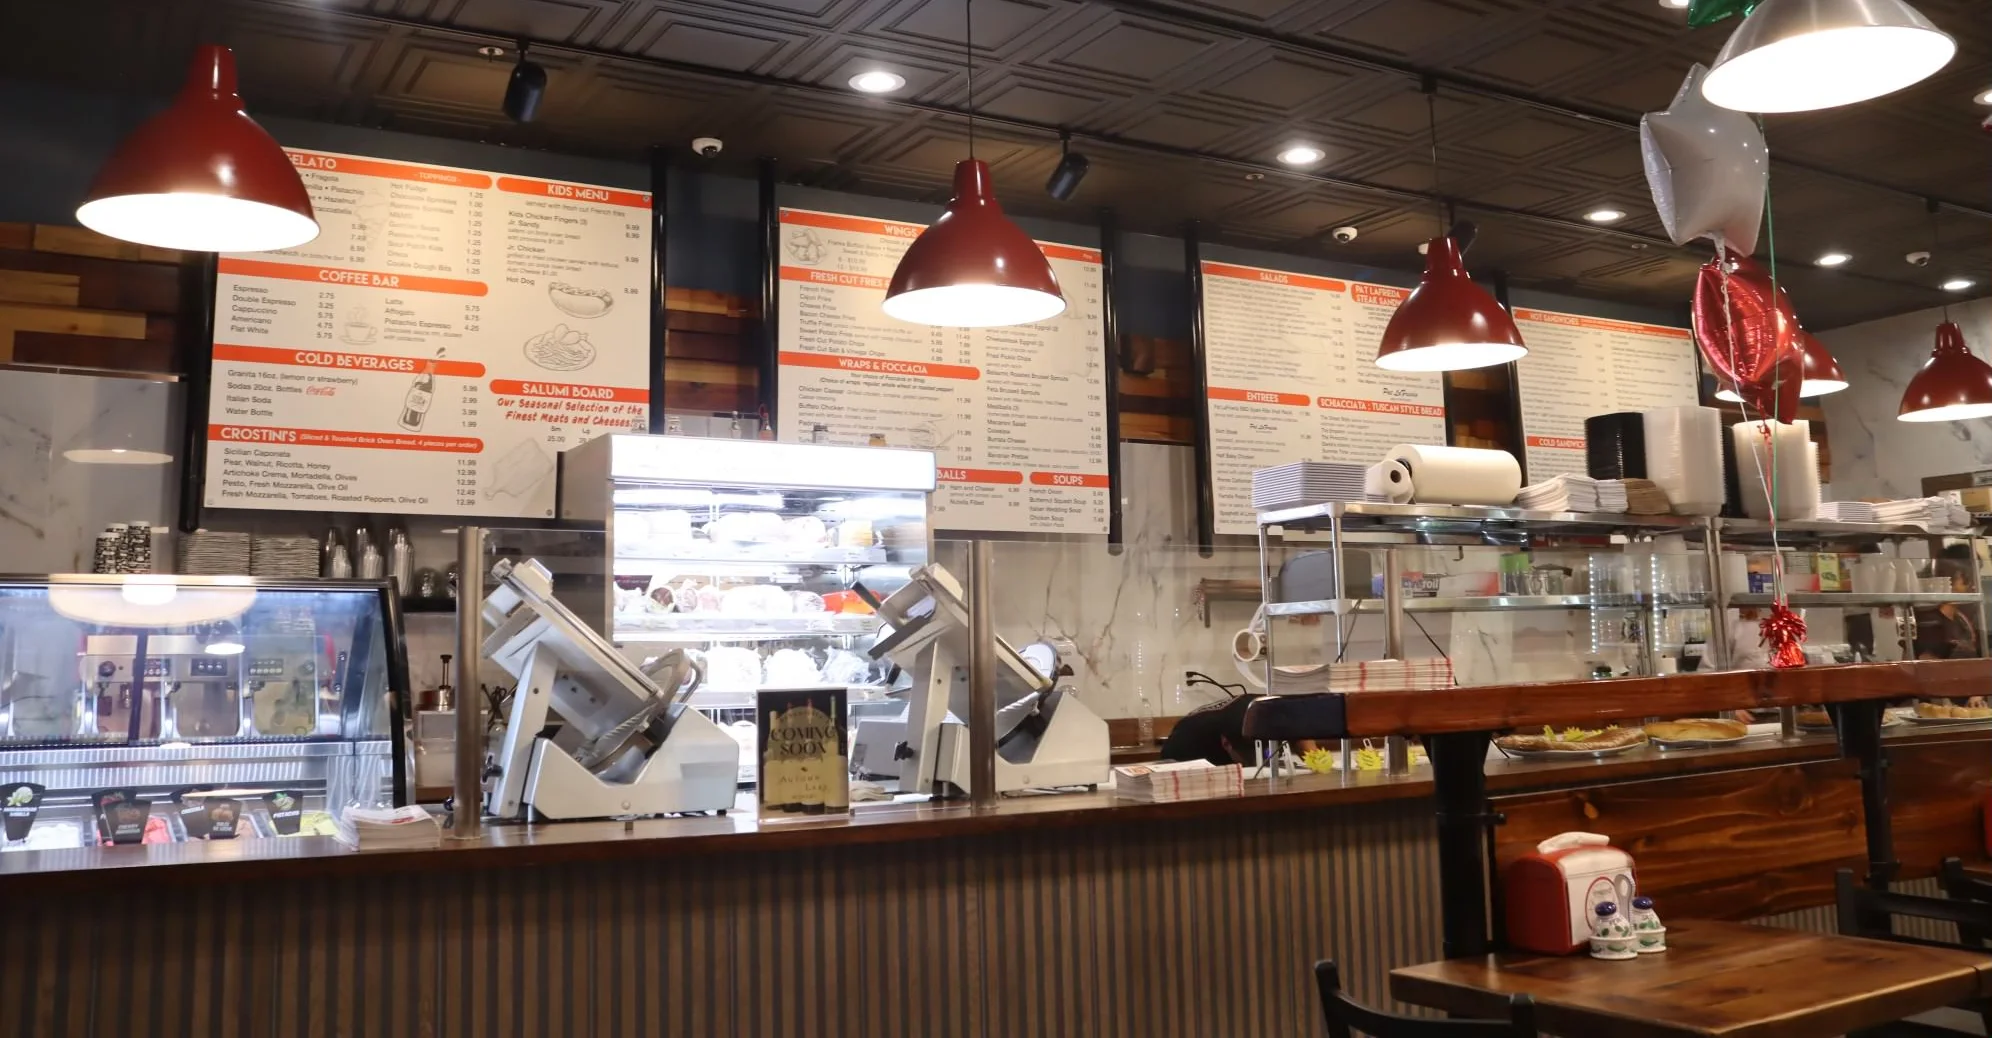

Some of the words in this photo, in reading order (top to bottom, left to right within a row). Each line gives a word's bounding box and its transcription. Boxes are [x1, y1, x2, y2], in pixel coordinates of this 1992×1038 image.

[547, 185, 572, 196] KIDS
[575, 190, 609, 201] MENU
[526, 212, 552, 221] Chicken
[554, 215, 578, 224] Fingers
[884, 225, 917, 238] WINGS
[517, 245, 545, 253] Chicken
[319, 269, 369, 284] COFFEE
[372, 274, 400, 287] BAR
[520, 277, 535, 286] Dog
[810, 271, 838, 282] FRESH
[839, 274, 858, 284] CUT
[1259, 272, 1288, 284] SALADS
[233, 284, 268, 294] Espresso
[232, 294, 259, 303] Double
[262, 297, 296, 306] Espresso
[232, 304, 278, 315] Cappuccino
[384, 307, 415, 316] Affogato
[231, 315, 272, 324] Americano
[384, 318, 417, 327] Pistachio
[419, 321, 452, 329] Espresso
[247, 326, 269, 334] White
[295, 352, 333, 365] COLD
[336, 354, 414, 371] BEVERAGES
[839, 359, 871, 370] WRAPS
[873, 362, 880, 370] &
[881, 362, 928, 374] FOCCACIA
[227, 369, 256, 378] Granita
[227, 382, 252, 390] Sodas
[276, 385, 302, 393] Bottles
[522, 383, 569, 396] SALUMI
[572, 388, 614, 399] BOARD
[251, 396, 272, 404] Soda
[497, 397, 515, 407] Our
[518, 398, 562, 410] Seasonal
[565, 402, 609, 413] Selection
[613, 405, 624, 414] of
[627, 405, 643, 415] the
[225, 407, 248, 415] Water
[250, 408, 273, 417] Bottle
[1372, 402, 1400, 413] TUSCAN
[1400, 404, 1420, 415] STYLE
[1421, 405, 1442, 415] BREAD
[505, 410, 537, 421] Finest
[540, 413, 569, 424] Meats
[572, 416, 589, 425] and
[220, 427, 297, 442] CROSTINI'S
[224, 448, 252, 456] Sicilian
[254, 449, 291, 458] Caponata
[307, 462, 331, 470] Honey
[223, 469, 260, 477] Artichoke
[335, 473, 357, 481] Olives
[1053, 475, 1083, 486] SOUPS
[331, 494, 362, 502] Roasted
[398, 496, 416, 504] Olive
[771, 726, 836, 742] COMING
[780, 741, 827, 756] SOON
